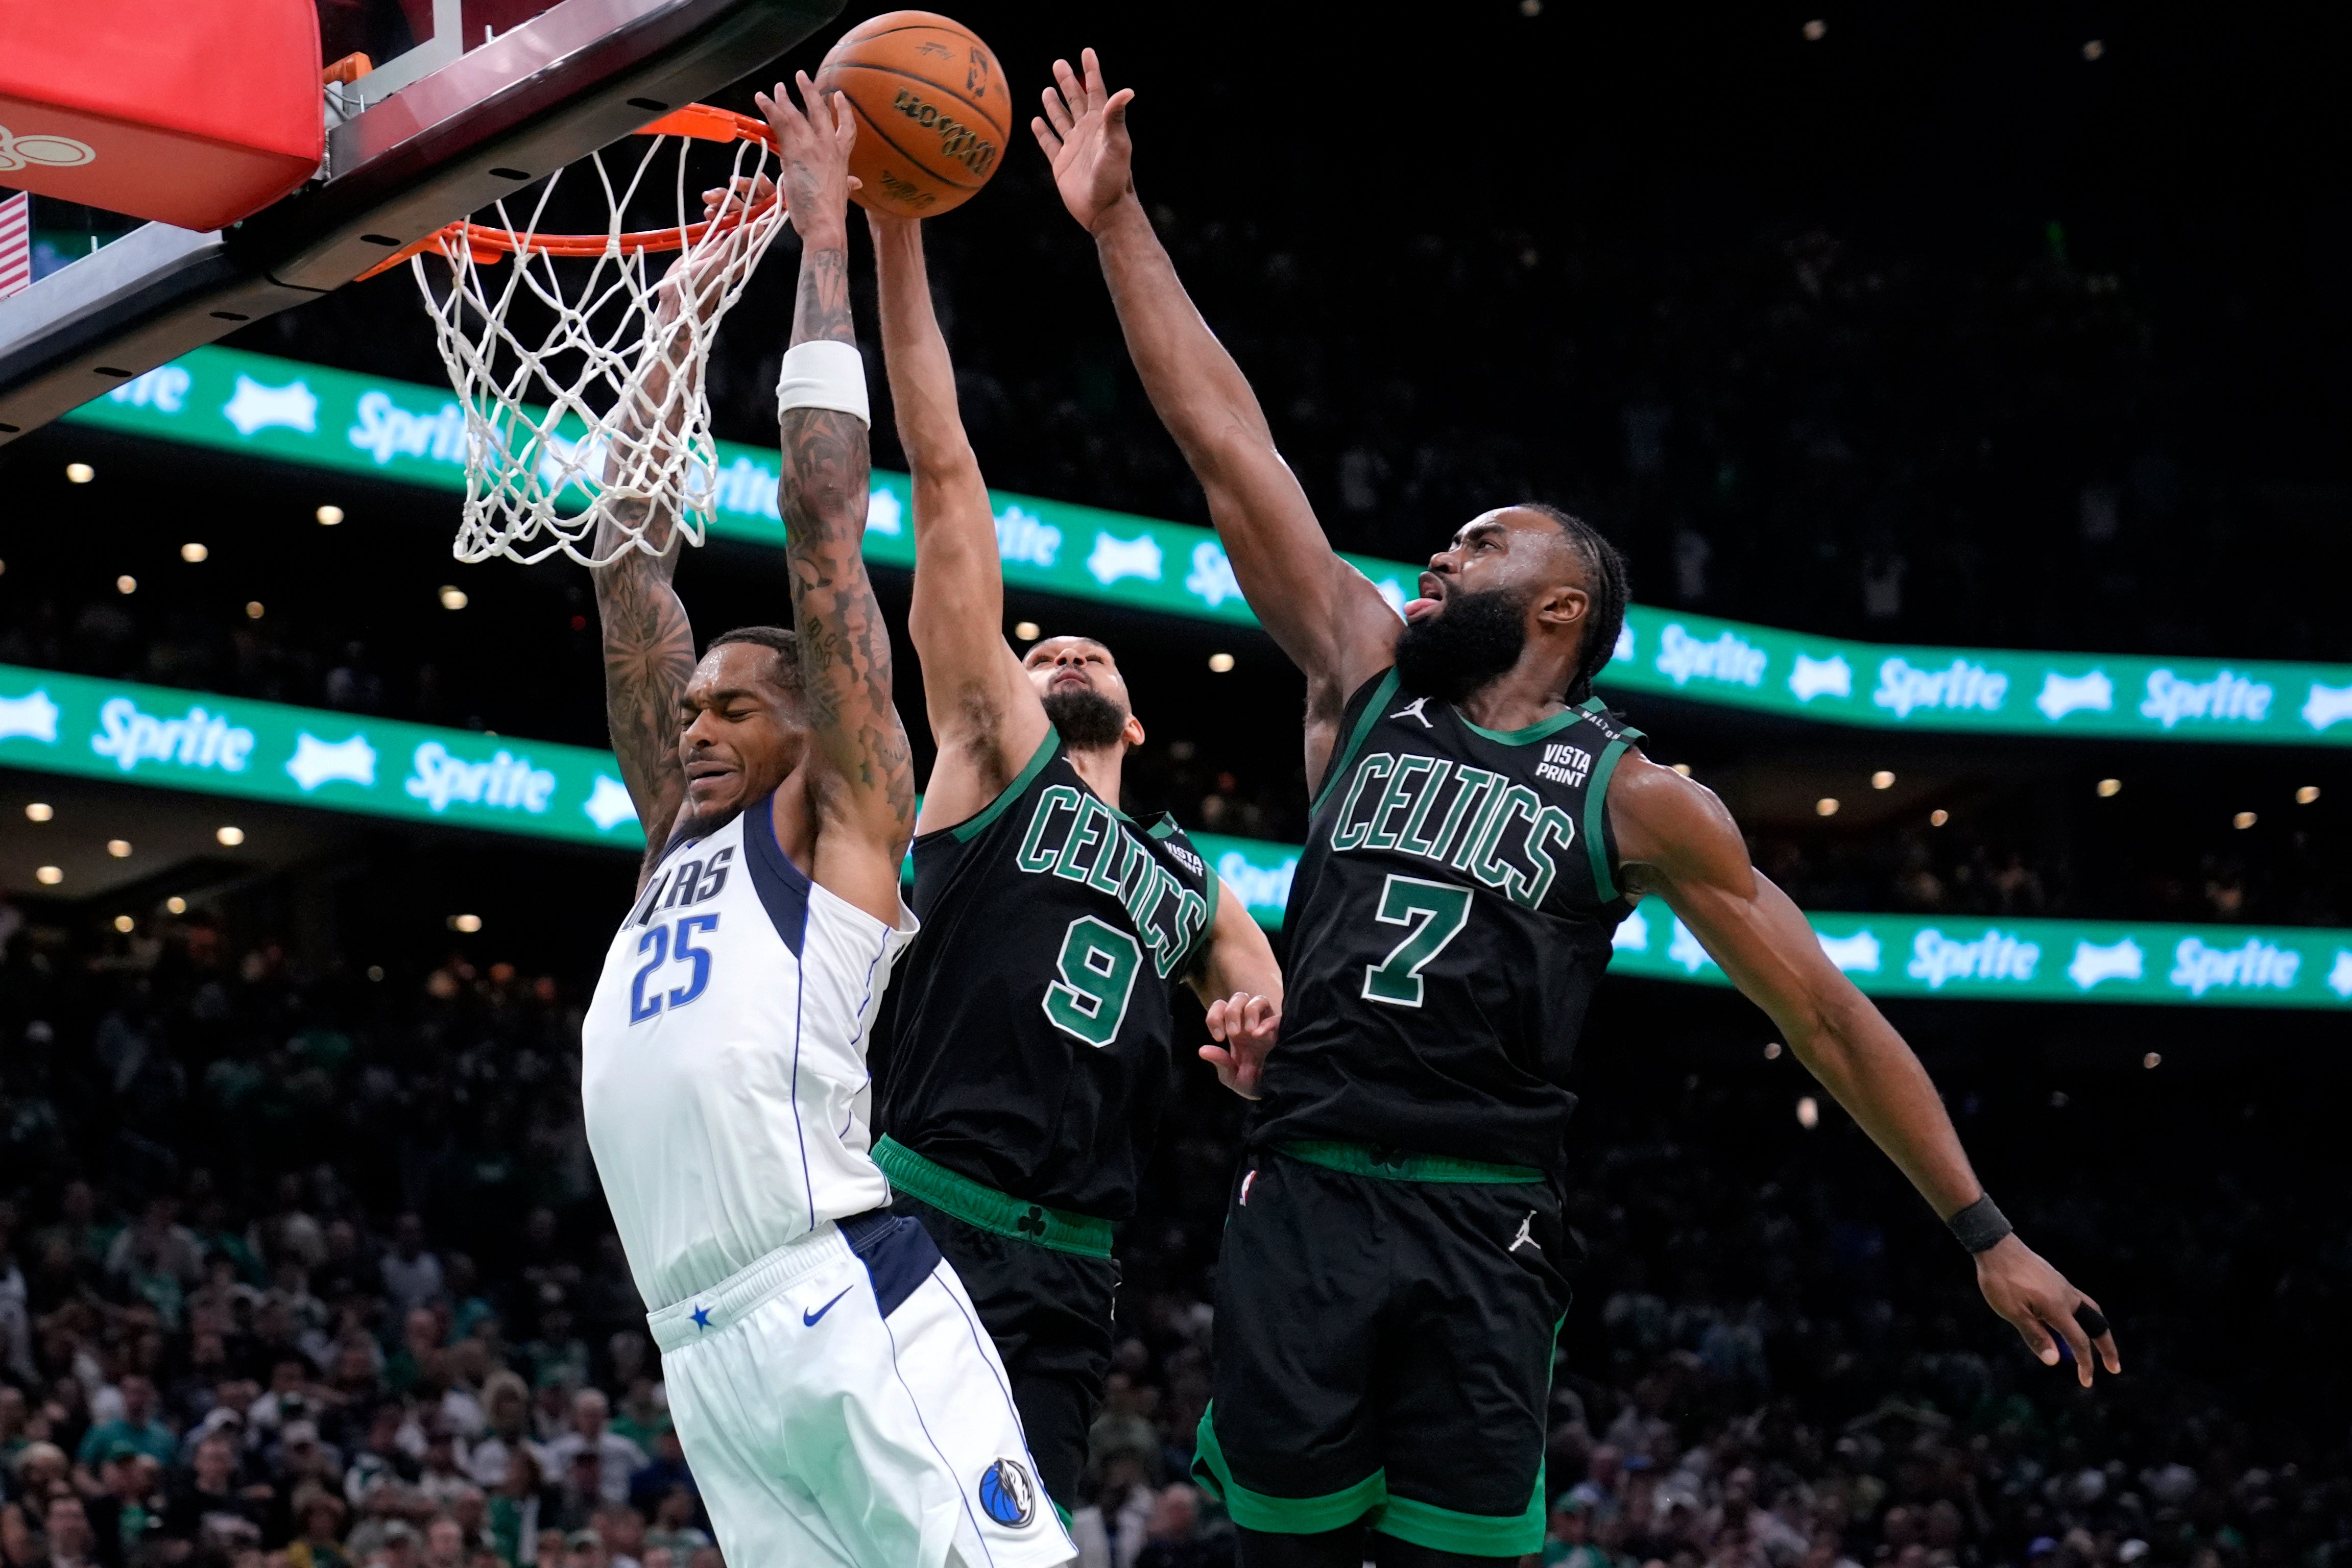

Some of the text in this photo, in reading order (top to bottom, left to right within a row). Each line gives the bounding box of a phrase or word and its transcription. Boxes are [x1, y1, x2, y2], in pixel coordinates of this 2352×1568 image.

[994, 506, 1062, 567] ite
[1657, 625, 1766, 685] Sprite
[1874, 659, 2007, 717] Sprite
[2141, 669, 2272, 728] Sprite
[92, 698, 254, 771] Sprite
[1581, 710, 1621, 740] WALTON
[406, 742, 555, 812] Sprite
[1535, 762, 1586, 787] PRINT
[1543, 744, 1592, 774] VISTA
[1164, 840, 1203, 869] VISTA
[1331, 752, 1575, 910] CELTICS
[619, 844, 737, 933] LAS
[1016, 784, 1207, 978] CELTICS
[1218, 852, 1298, 910] Spri
[629, 912, 721, 1027] 25
[1361, 874, 1474, 1007] 7
[1909, 929, 2038, 987] Sprite
[2171, 938, 2299, 995] Sprite
[1042, 914, 1143, 1048] 9
